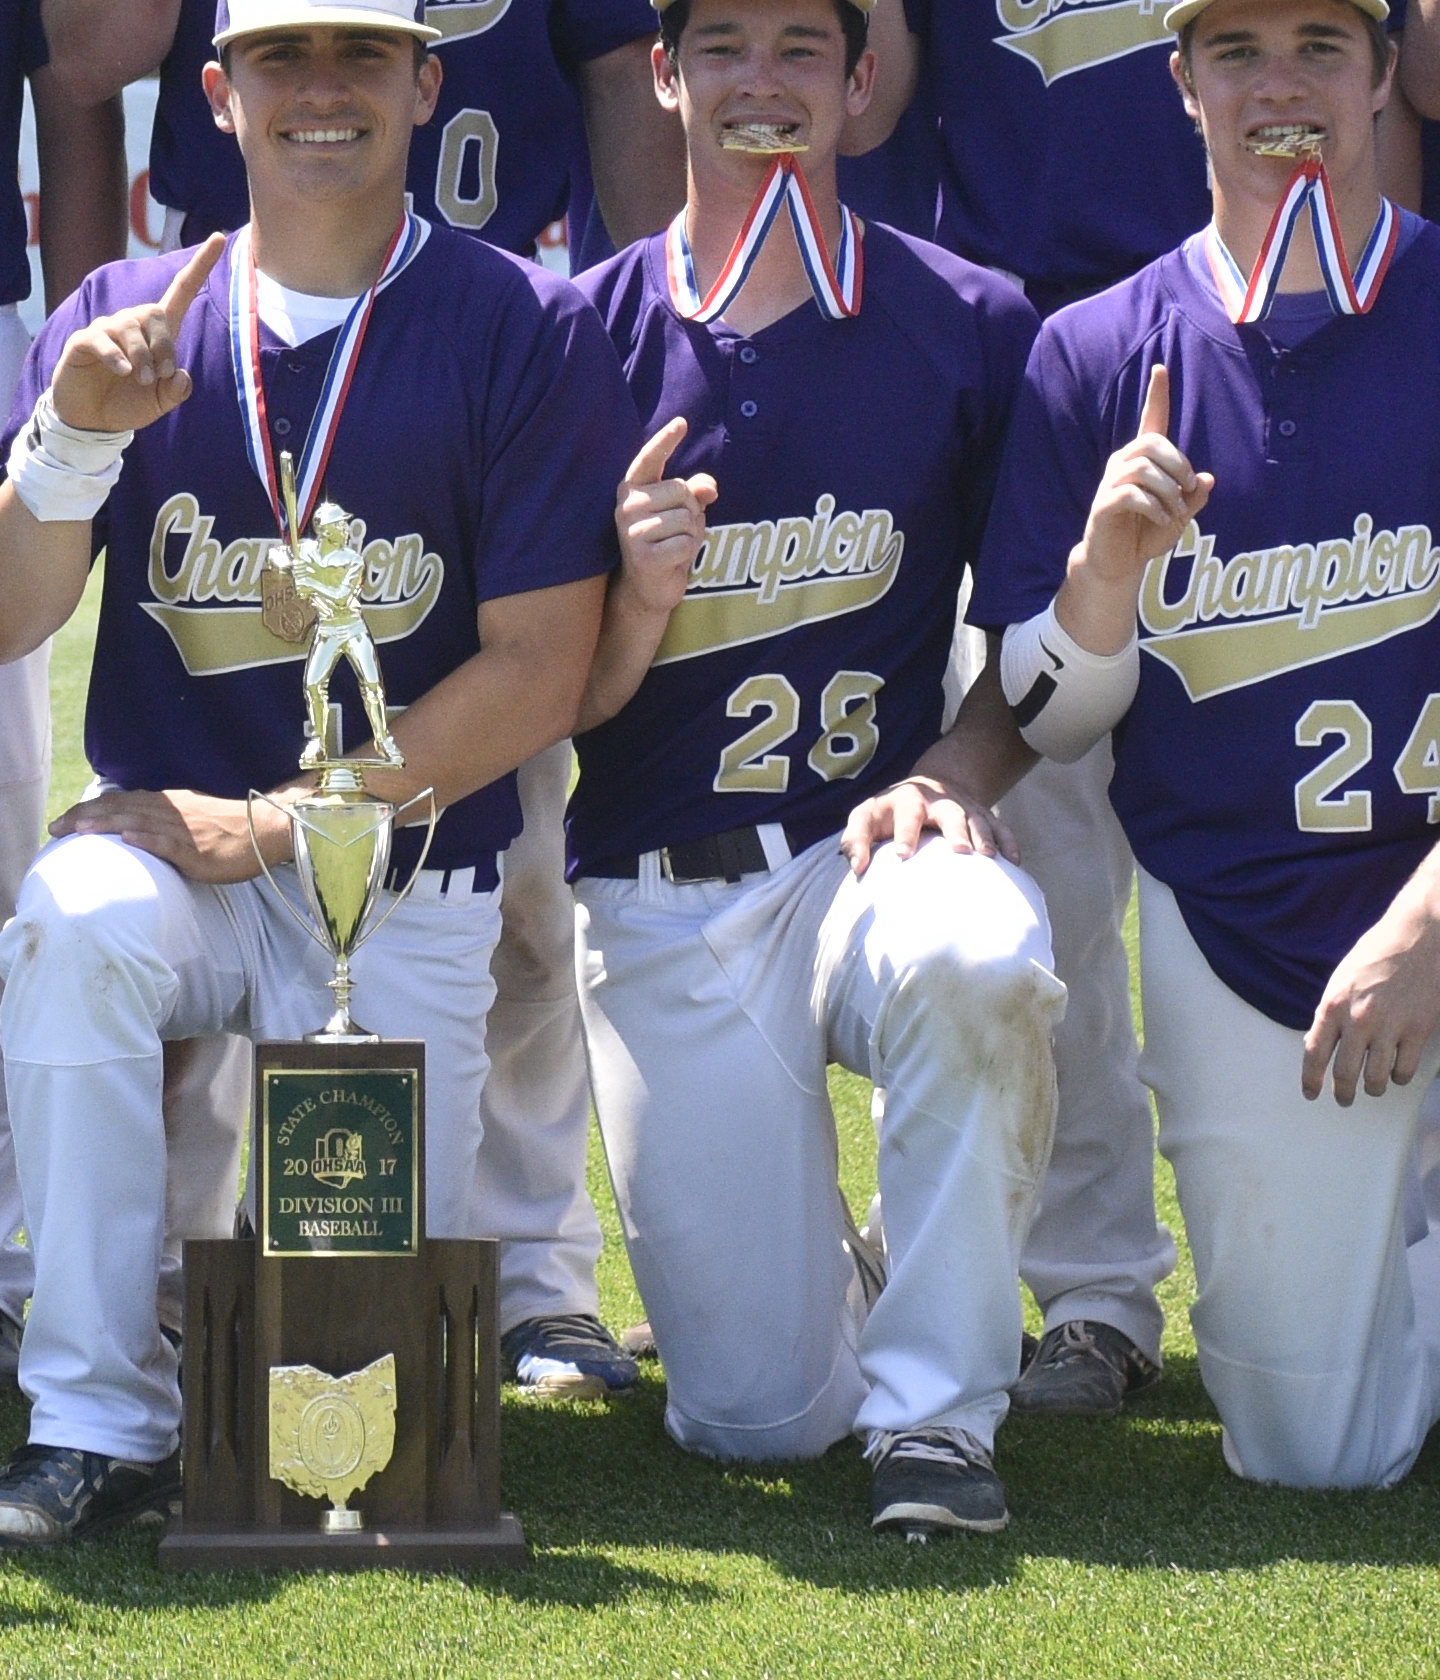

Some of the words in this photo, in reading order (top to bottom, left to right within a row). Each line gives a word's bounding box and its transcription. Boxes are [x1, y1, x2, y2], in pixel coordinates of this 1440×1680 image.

[148, 492, 444, 605] Chaion
[687, 492, 905, 605] ampion
[713, 669, 886, 794] 28
[277, 1097, 317, 1146] STATE
[320, 1089, 404, 1145] CHAMPION
[283, 1158, 308, 1176] 20
[311, 1157, 367, 1175] OHSAA
[379, 1158, 397, 1176] 17
[279, 1197, 374, 1214] DIVISION
[381, 1197, 403, 1213] III
[298, 1220, 383, 1237] BASEBALL
